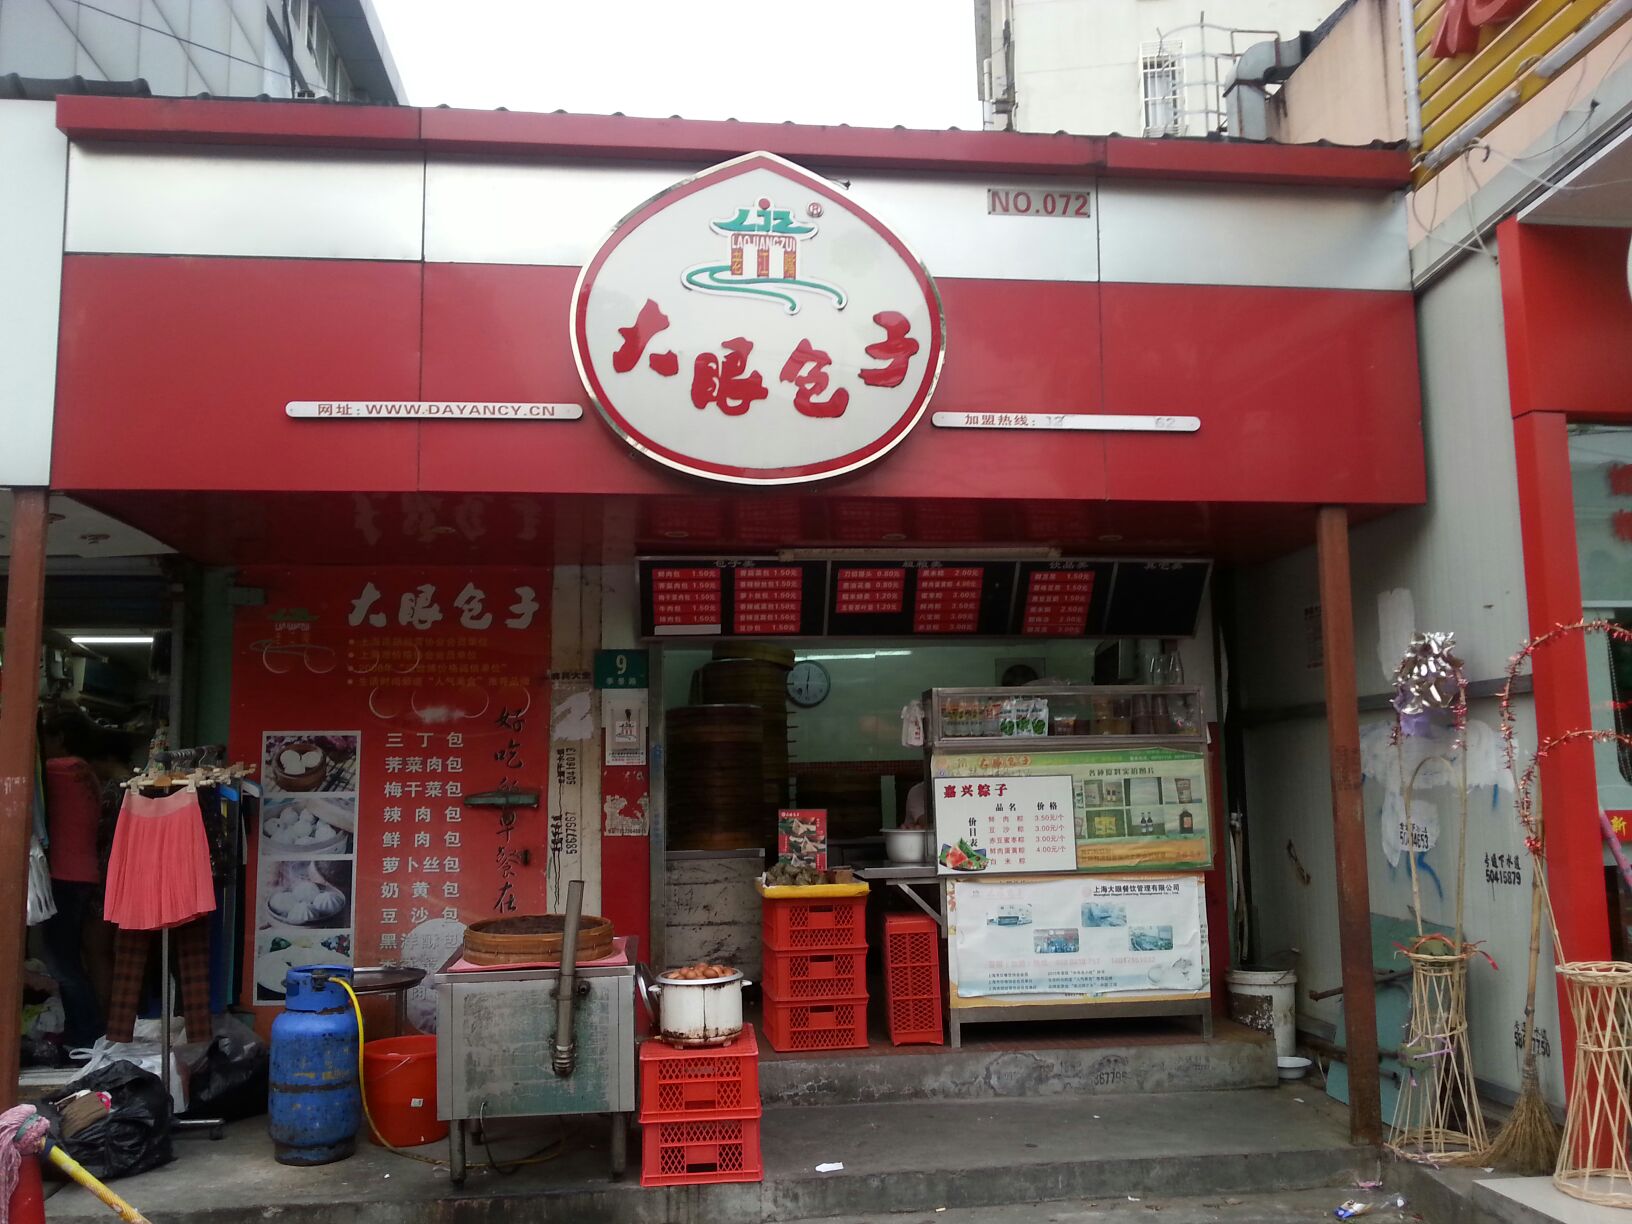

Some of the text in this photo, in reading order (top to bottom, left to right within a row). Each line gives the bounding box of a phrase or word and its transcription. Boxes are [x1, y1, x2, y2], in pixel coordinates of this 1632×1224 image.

[991, 191, 1088, 216] NO.072
[612, 298, 920, 418] 大眼包子
[348, 582, 540, 630] 大眼包子
[616, 654, 627, 675] 9
[385, 732, 464, 748] 三丁包
[385, 756, 463, 773] 荠菜肉包
[384, 781, 463, 798] 梅干菜包
[943, 784, 1007, 798] 嘉兴粽子
[384, 806, 462, 823] 辣肉包
[995, 801, 1057, 812] 品名 价格
[382, 831, 462, 848] 鲜肉包
[968, 817, 978, 847] 价目表
[382, 856, 460, 874] 萝卜丝包
[1485, 868, 1522, 886] 50415879
[380, 882, 460, 898] 奶黄包
[380, 907, 459, 924] 豆沙包
